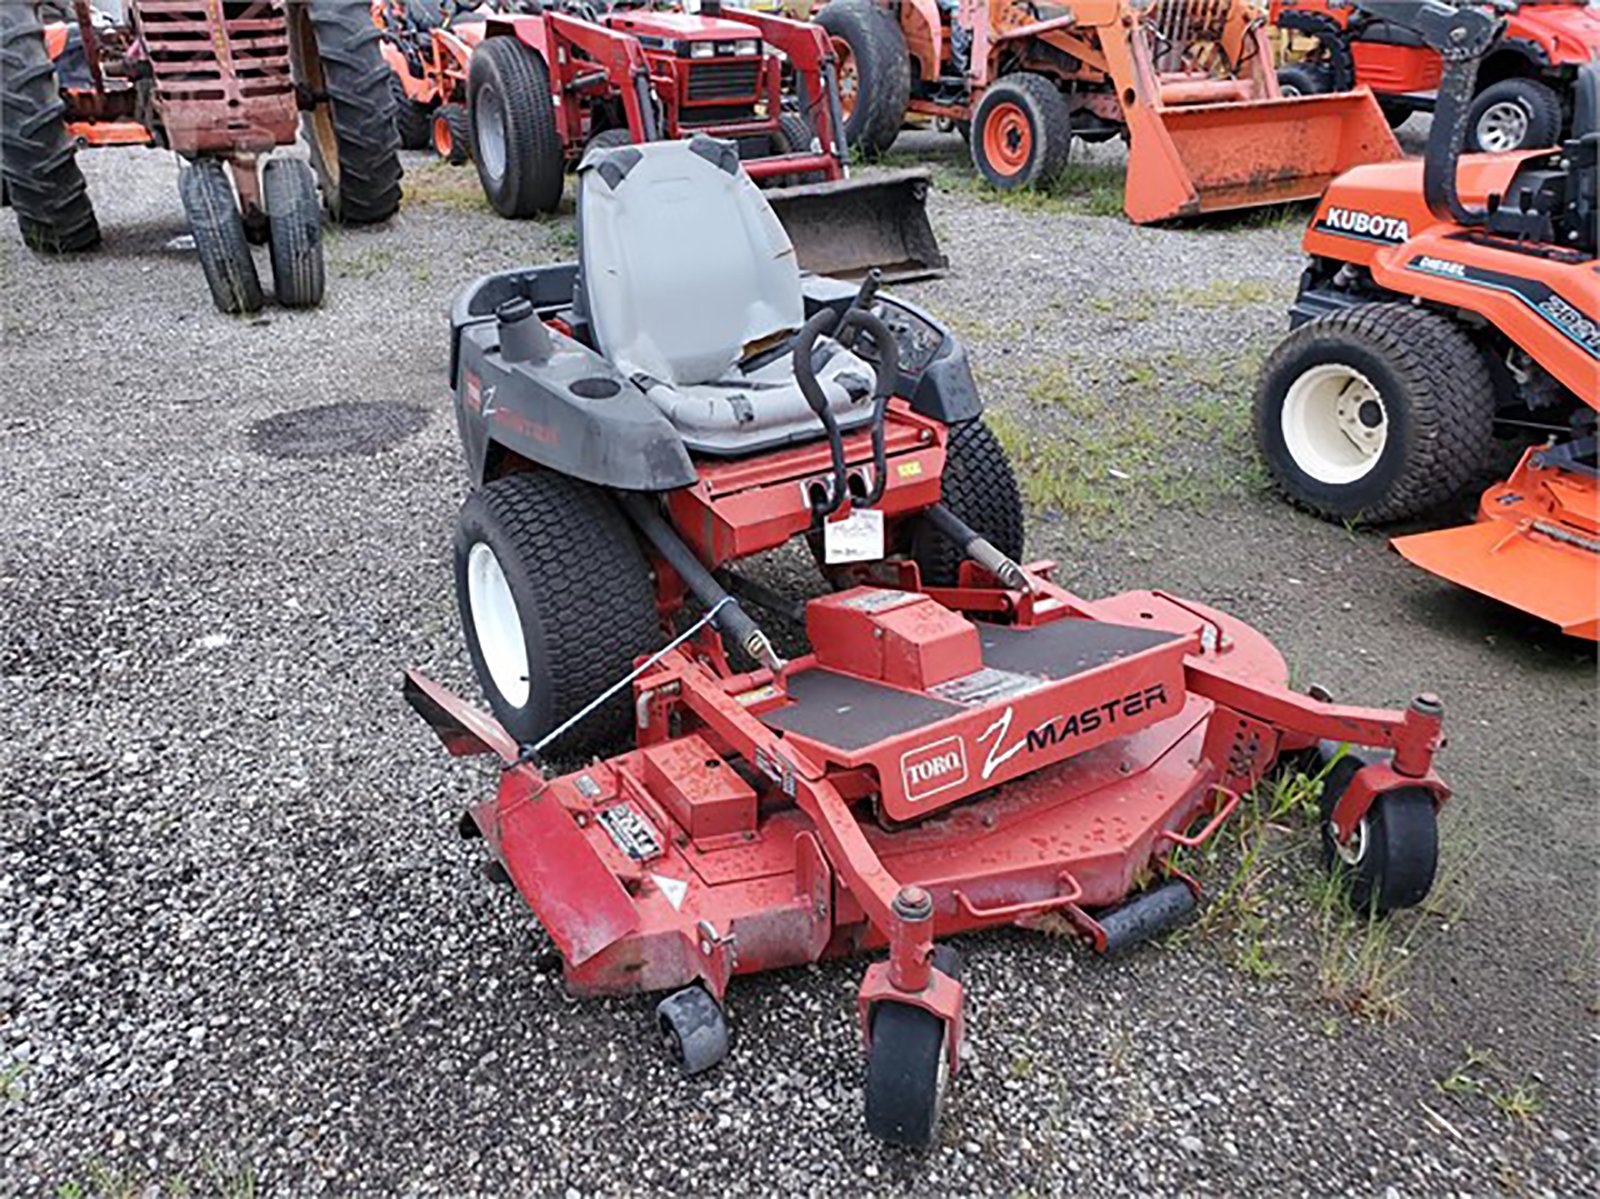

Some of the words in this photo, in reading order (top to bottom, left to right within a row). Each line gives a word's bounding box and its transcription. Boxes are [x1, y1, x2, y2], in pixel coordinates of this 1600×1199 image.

[1326, 207, 1409, 243] KUBOTA
[977, 706, 1060, 779] Z
[1026, 684, 1168, 752] MASTER
[907, 751, 961, 784] TORO
